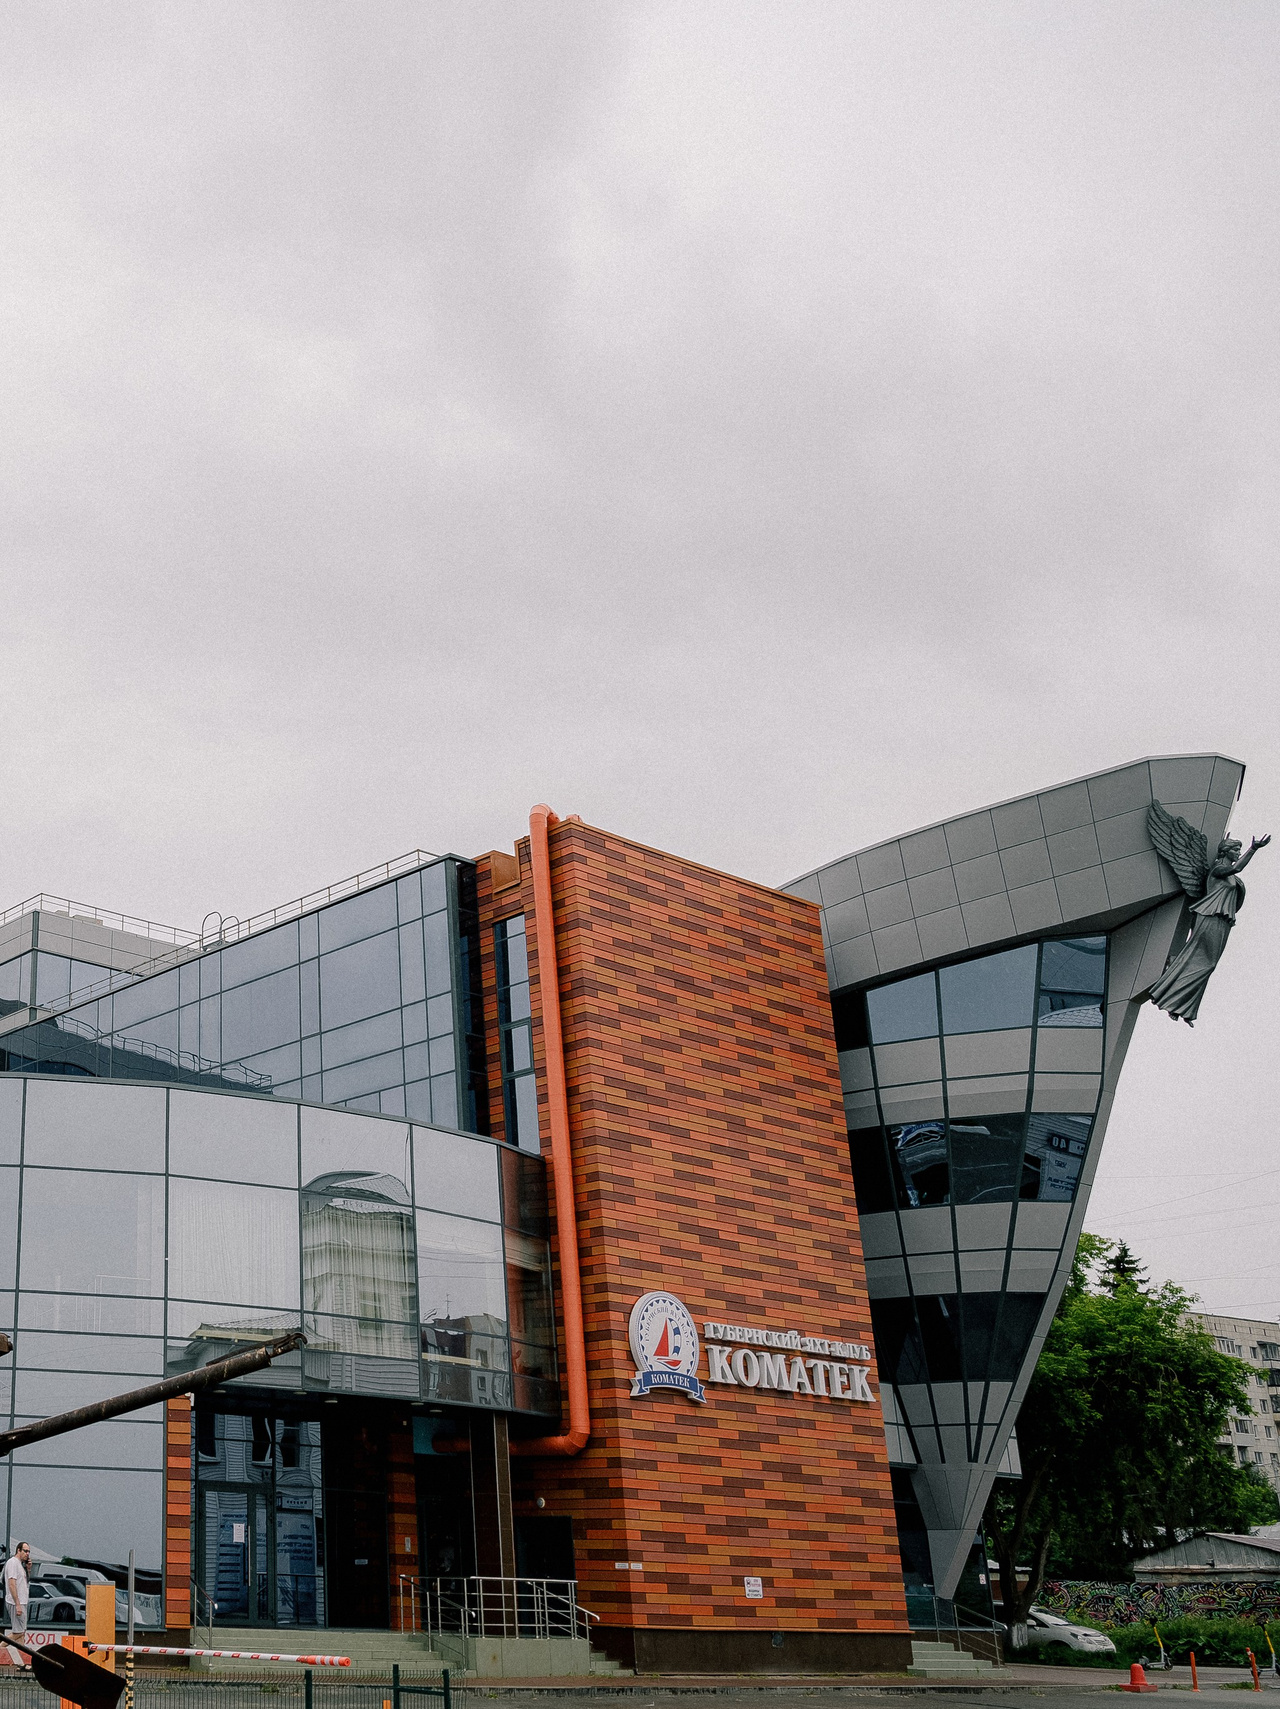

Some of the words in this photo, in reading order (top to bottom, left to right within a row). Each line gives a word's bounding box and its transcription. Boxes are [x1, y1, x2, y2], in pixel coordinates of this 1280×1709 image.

[703, 1322, 802, 1350] ГУБЕРНСКИЙ
[800, 1337, 872, 1361] ЯХТ-КЛУБ
[651, 1374, 690, 1387] КОМАТЕК
[705, 1345, 876, 1402] КОМАТЕК
[23, 1632, 56, 1646] ХОД
